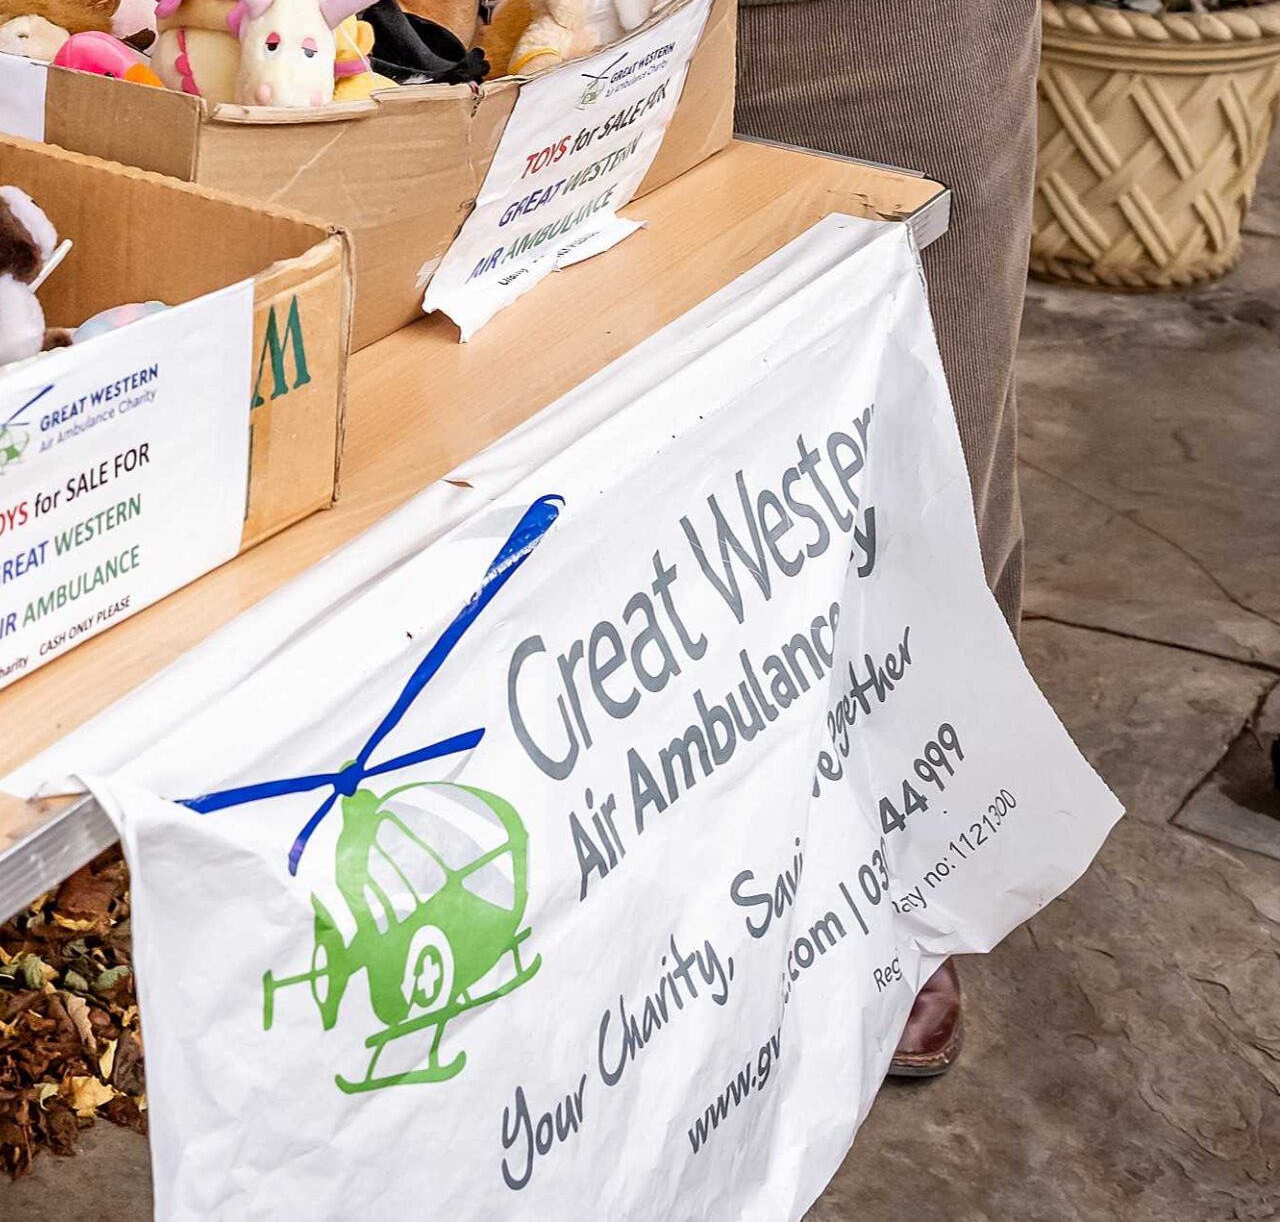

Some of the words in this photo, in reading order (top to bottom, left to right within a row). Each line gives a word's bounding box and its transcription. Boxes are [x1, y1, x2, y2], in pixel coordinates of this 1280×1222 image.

[610, 61, 638, 84] GREAT
[638, 42, 676, 70] WESTERN
[498, 179, 566, 227] GREAT
[562, 131, 643, 196] WESTERN
[521, 135, 572, 179] TOYS
[570, 127, 599, 155] for
[597, 99, 643, 140] SALE
[465, 246, 505, 285] AIR
[501, 183, 618, 265] AMBULANCE
[39, 438, 54, 453] Air
[57, 408, 115, 444] Ambulance
[119, 389, 157, 414] Charity
[40, 396, 87, 432] GREAT
[90, 363, 158, 407] WESTERN
[34, 490, 61, 518] for
[66, 461, 109, 503] SALE
[114, 442, 151, 479] FOR
[53, 493, 142, 557] WESTERN
[21, 544, 141, 629] AMBULANCE
[39, 632, 67, 657] CASH
[68, 617, 94, 640] ONLY
[95, 594, 132, 624] PLEASE
[508, 549, 708, 783] Great
[680, 403, 875, 626] Wester
[913, 722, 966, 792] 999
[567, 788, 625, 903] Air
[923, 855, 957, 891] no:
[948, 787, 1017, 860] 1121300
[501, 1074, 588, 1191] Your
[598, 932, 736, 1088] Charity,
